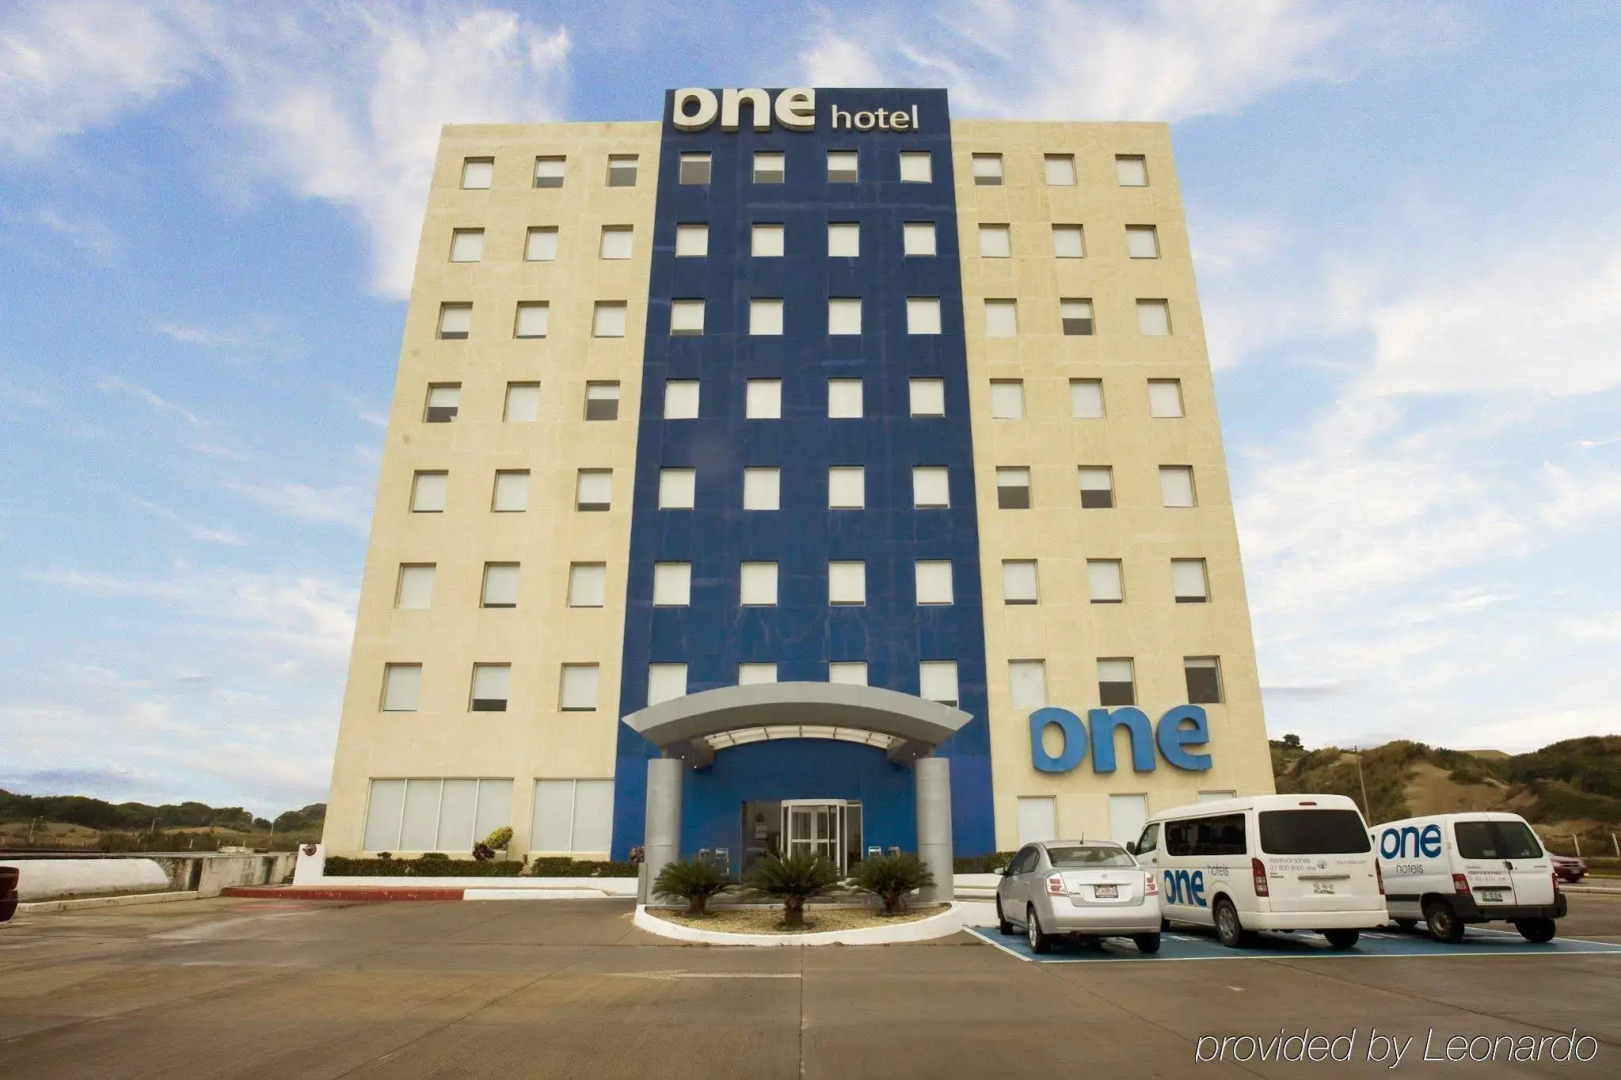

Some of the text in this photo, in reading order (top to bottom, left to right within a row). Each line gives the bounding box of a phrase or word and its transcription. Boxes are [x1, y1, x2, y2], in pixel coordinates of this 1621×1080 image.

[673, 87, 919, 132] one hotel
[1029, 703, 1213, 773] one
[1380, 824, 1442, 859] one
[1207, 863, 1229, 877] hotels
[1396, 863, 1424, 874] hotels
[1164, 869, 1207, 907] one
